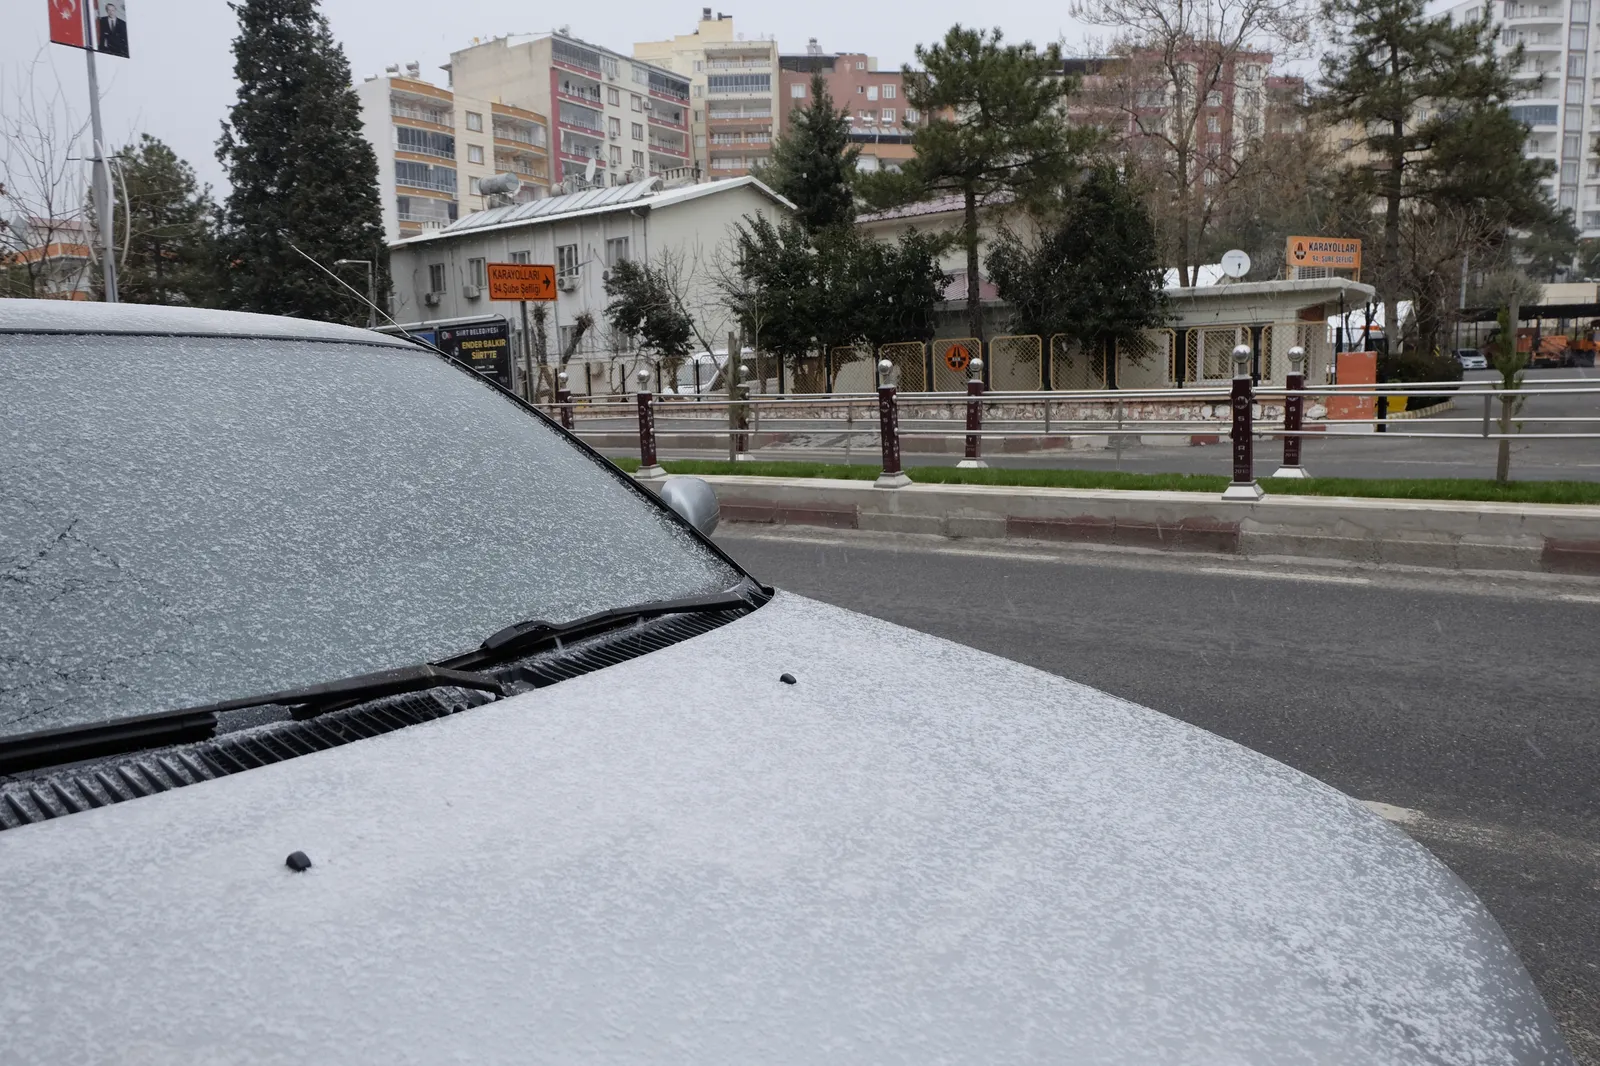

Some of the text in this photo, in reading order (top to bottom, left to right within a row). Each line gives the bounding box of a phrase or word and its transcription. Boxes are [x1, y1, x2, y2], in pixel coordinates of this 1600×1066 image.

[1308, 242, 1358, 253] KARAYOLLARI
[492, 269, 540, 280] KARAYOLLARI
[461, 338, 506, 350] ENDER BALKIR
